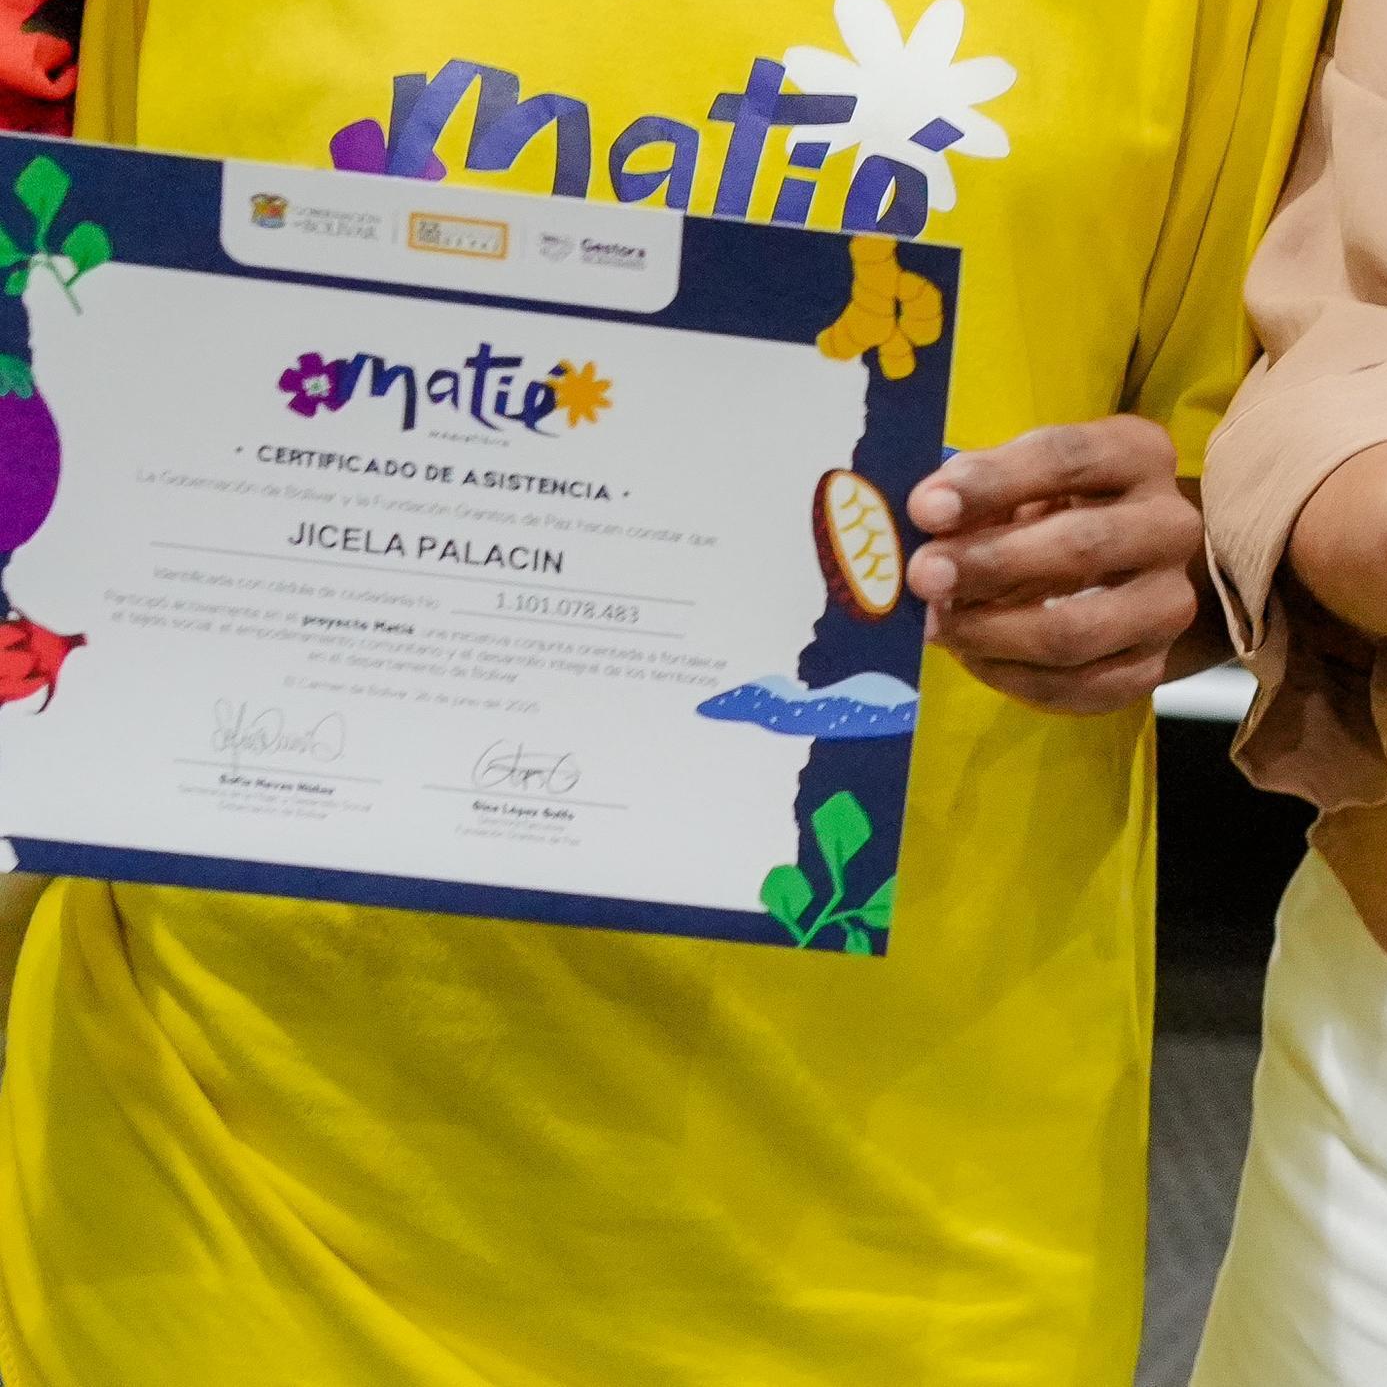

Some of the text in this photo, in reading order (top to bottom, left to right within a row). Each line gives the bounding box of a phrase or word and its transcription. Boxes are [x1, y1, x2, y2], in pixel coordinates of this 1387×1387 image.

[255, 444, 611, 501] CERTIFICADO DE ASISTENCIA
[286, 519, 564, 574] JICELA PALACIN
